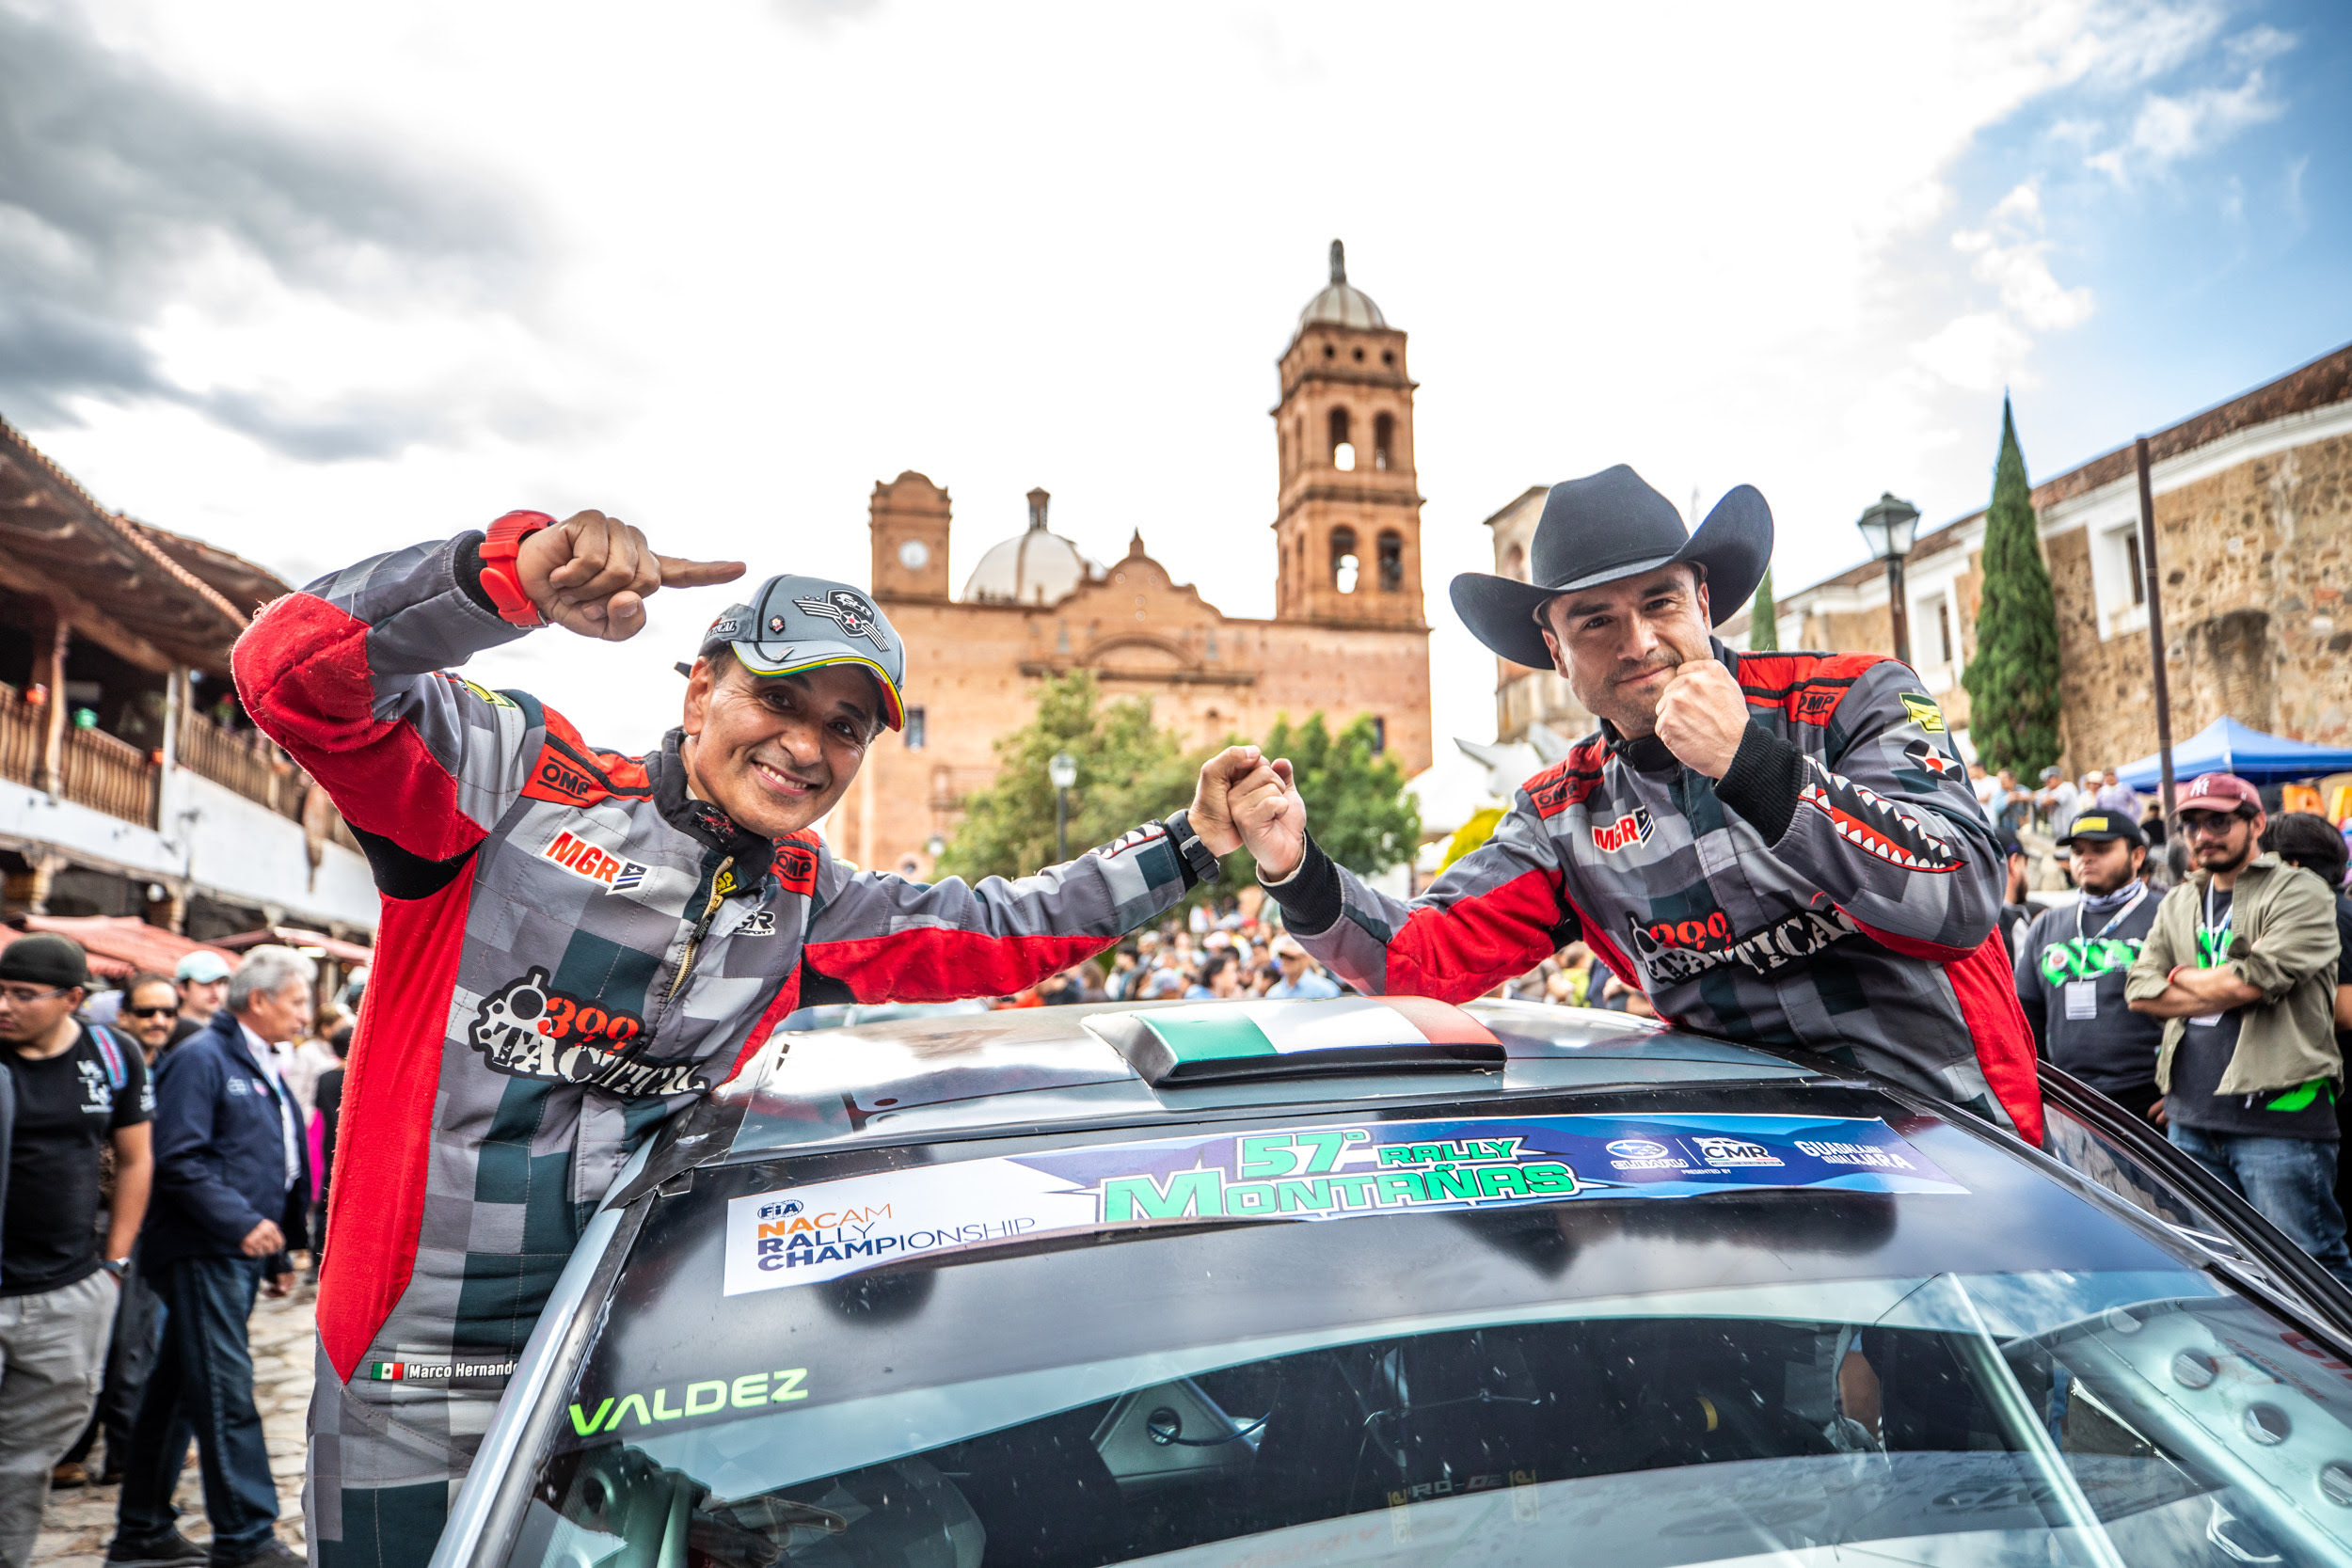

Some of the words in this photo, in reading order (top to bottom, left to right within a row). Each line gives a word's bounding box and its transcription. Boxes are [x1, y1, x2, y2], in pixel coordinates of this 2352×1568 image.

[1798, 694, 1835, 711] OMP
[542, 763, 590, 796] OMP
[1538, 784, 1578, 805] OMP
[1594, 816, 1639, 851] MGR
[546, 831, 621, 883] MGR
[776, 854, 812, 878] OMP
[1379, 1141, 1512, 1164] RALLY
[1611, 1158, 1689, 1169] SUBARU
[1706, 1146, 1768, 1158] CMR
[758, 1203, 892, 1239] NACAM
[757, 1218, 1035, 1272] CHAMPIONSHIP
[758, 1222, 875, 1255] RALLY
[409, 1364, 452, 1379] Marco
[569, 1368, 809, 1436] VALDEZ
